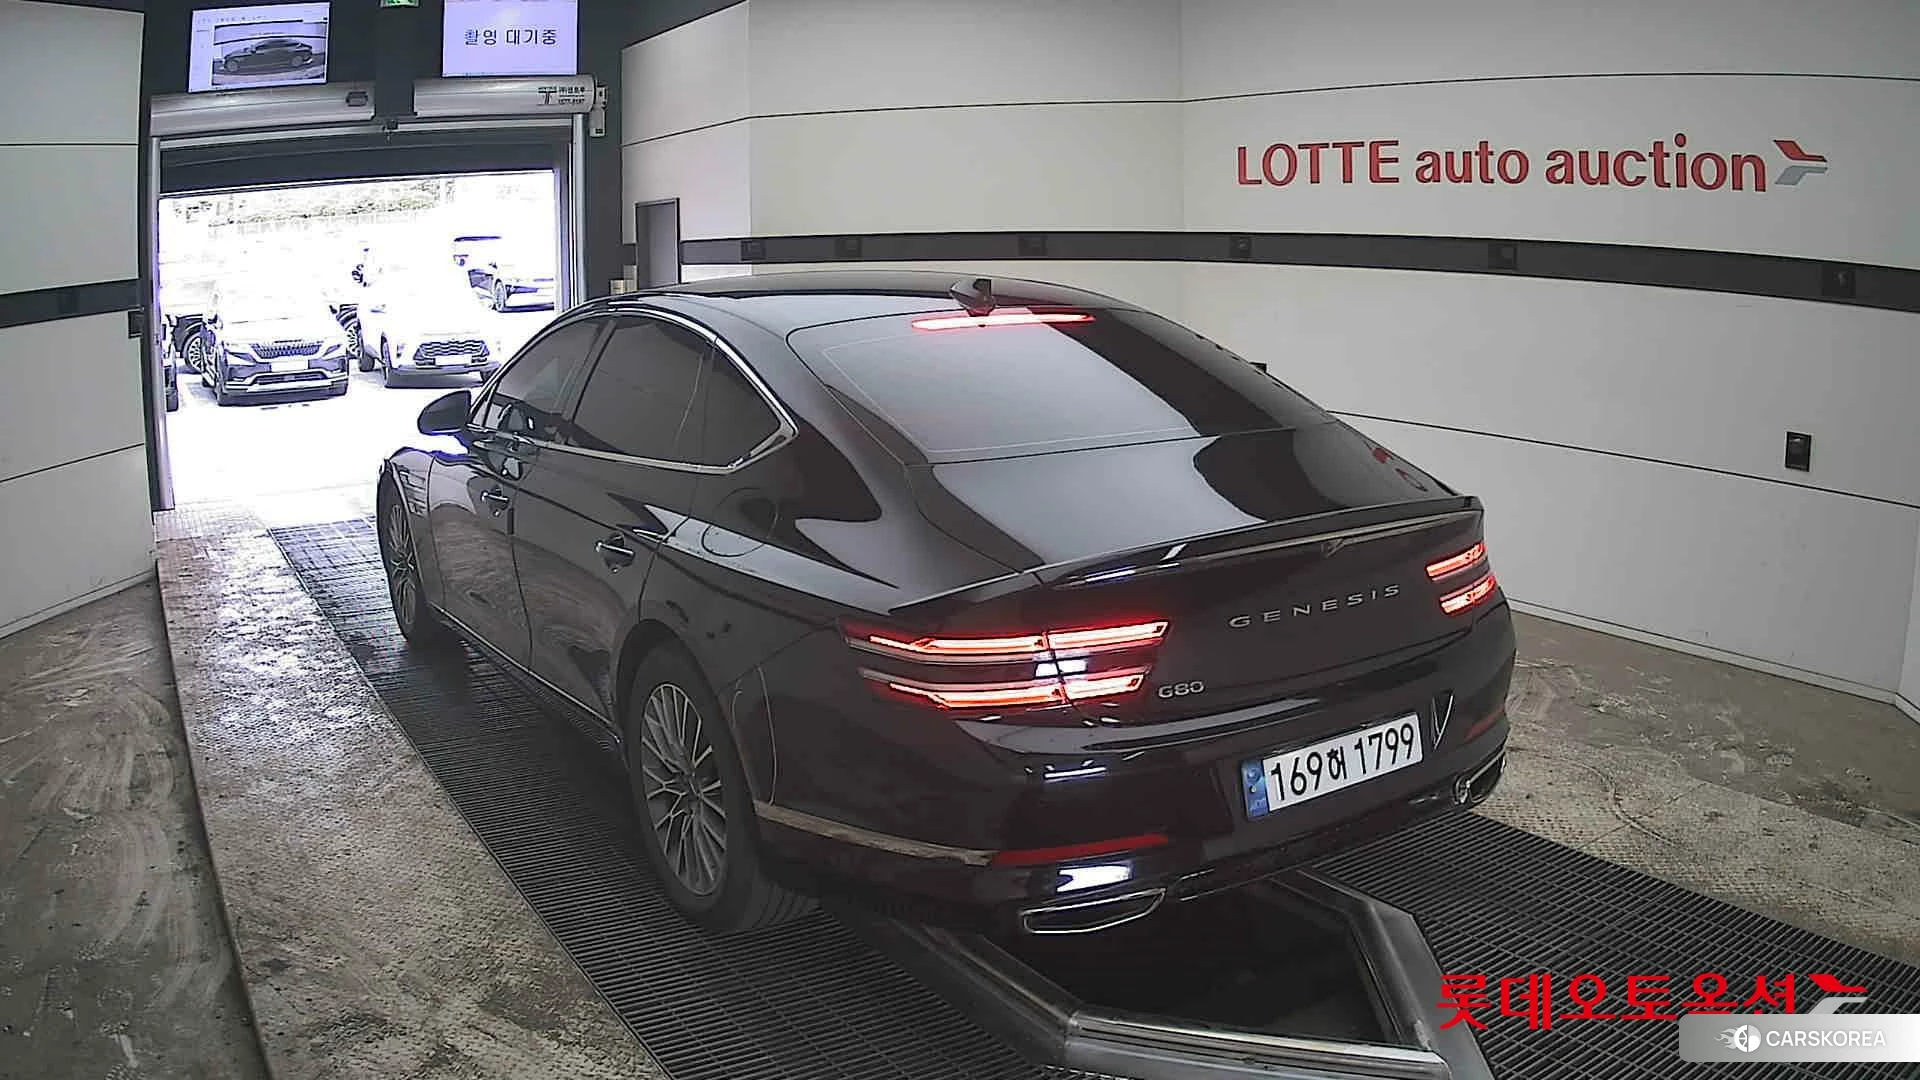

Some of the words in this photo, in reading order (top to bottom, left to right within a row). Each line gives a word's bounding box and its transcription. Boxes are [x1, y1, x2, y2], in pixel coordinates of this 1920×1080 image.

[506, 29, 556, 45] 대기중
[1237, 140, 1400, 186] LOTTE
[1415, 140, 1530, 185] auto
[1544, 132, 1767, 192] auction
[1229, 584, 1400, 628] GENESIS
[1158, 681, 1204, 699] G80
[1271, 746, 1348, 801] 169허
[1354, 723, 1414, 775] 1799
